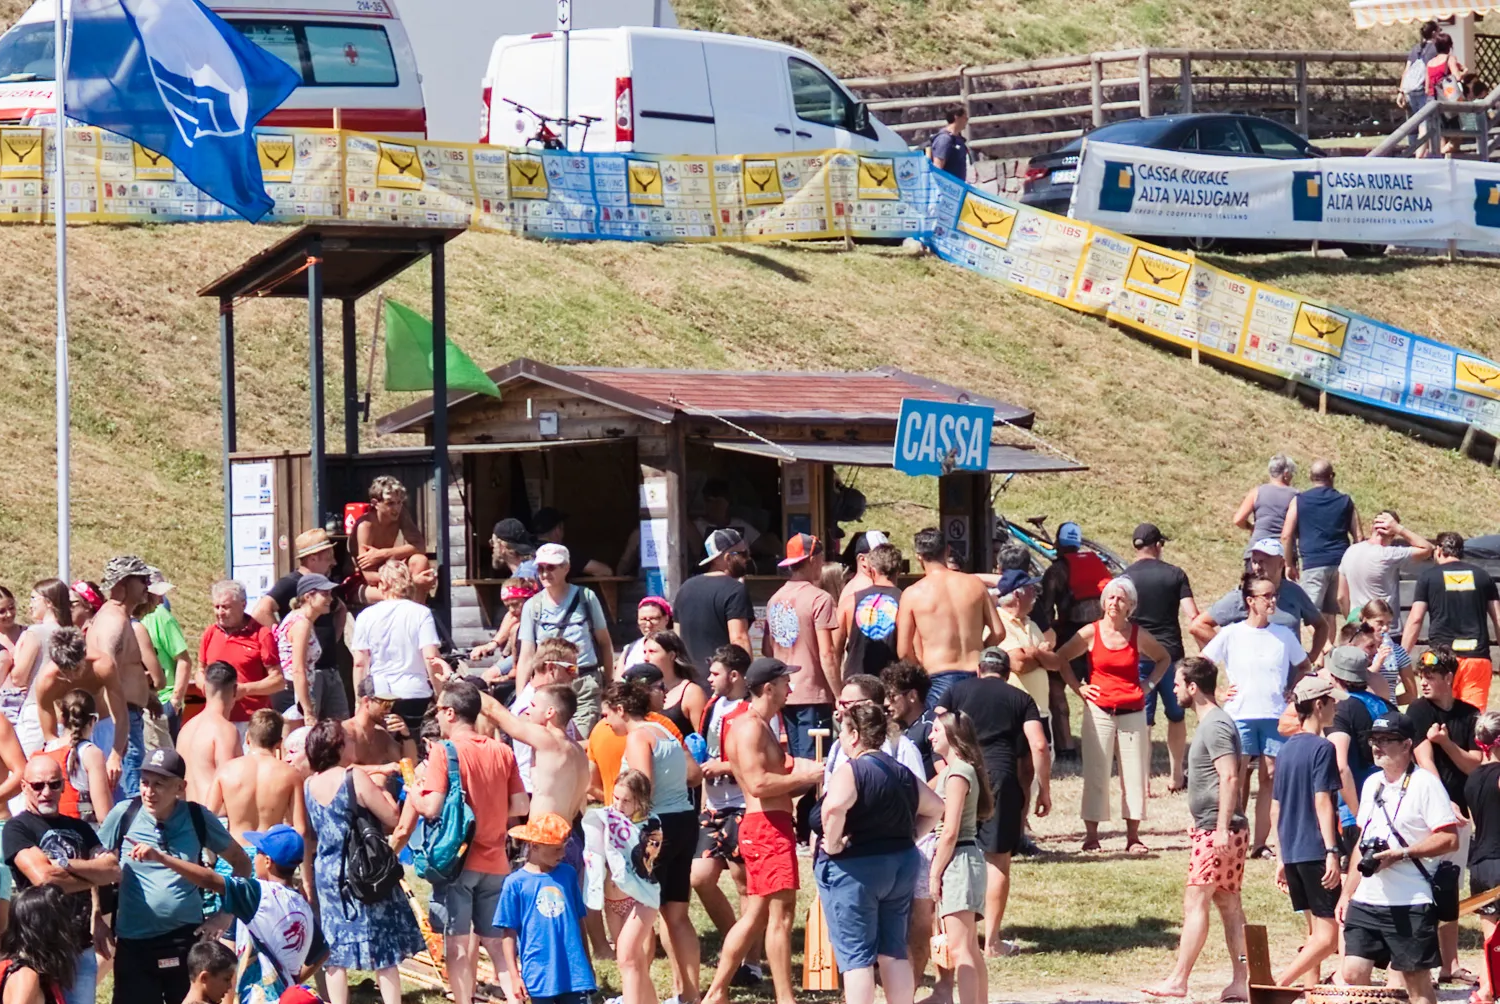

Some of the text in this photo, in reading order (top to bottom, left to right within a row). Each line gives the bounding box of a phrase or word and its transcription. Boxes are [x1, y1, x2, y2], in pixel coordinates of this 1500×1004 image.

[1138, 164, 1230, 186] CASSA RURALE
[1326, 171, 1414, 191] CASSA RURALE
[1138, 186, 1250, 208] ALTA VALSUGANA
[1326, 193, 1434, 212] ALTA VALSUGANA
[902, 411, 984, 467] CASSA
